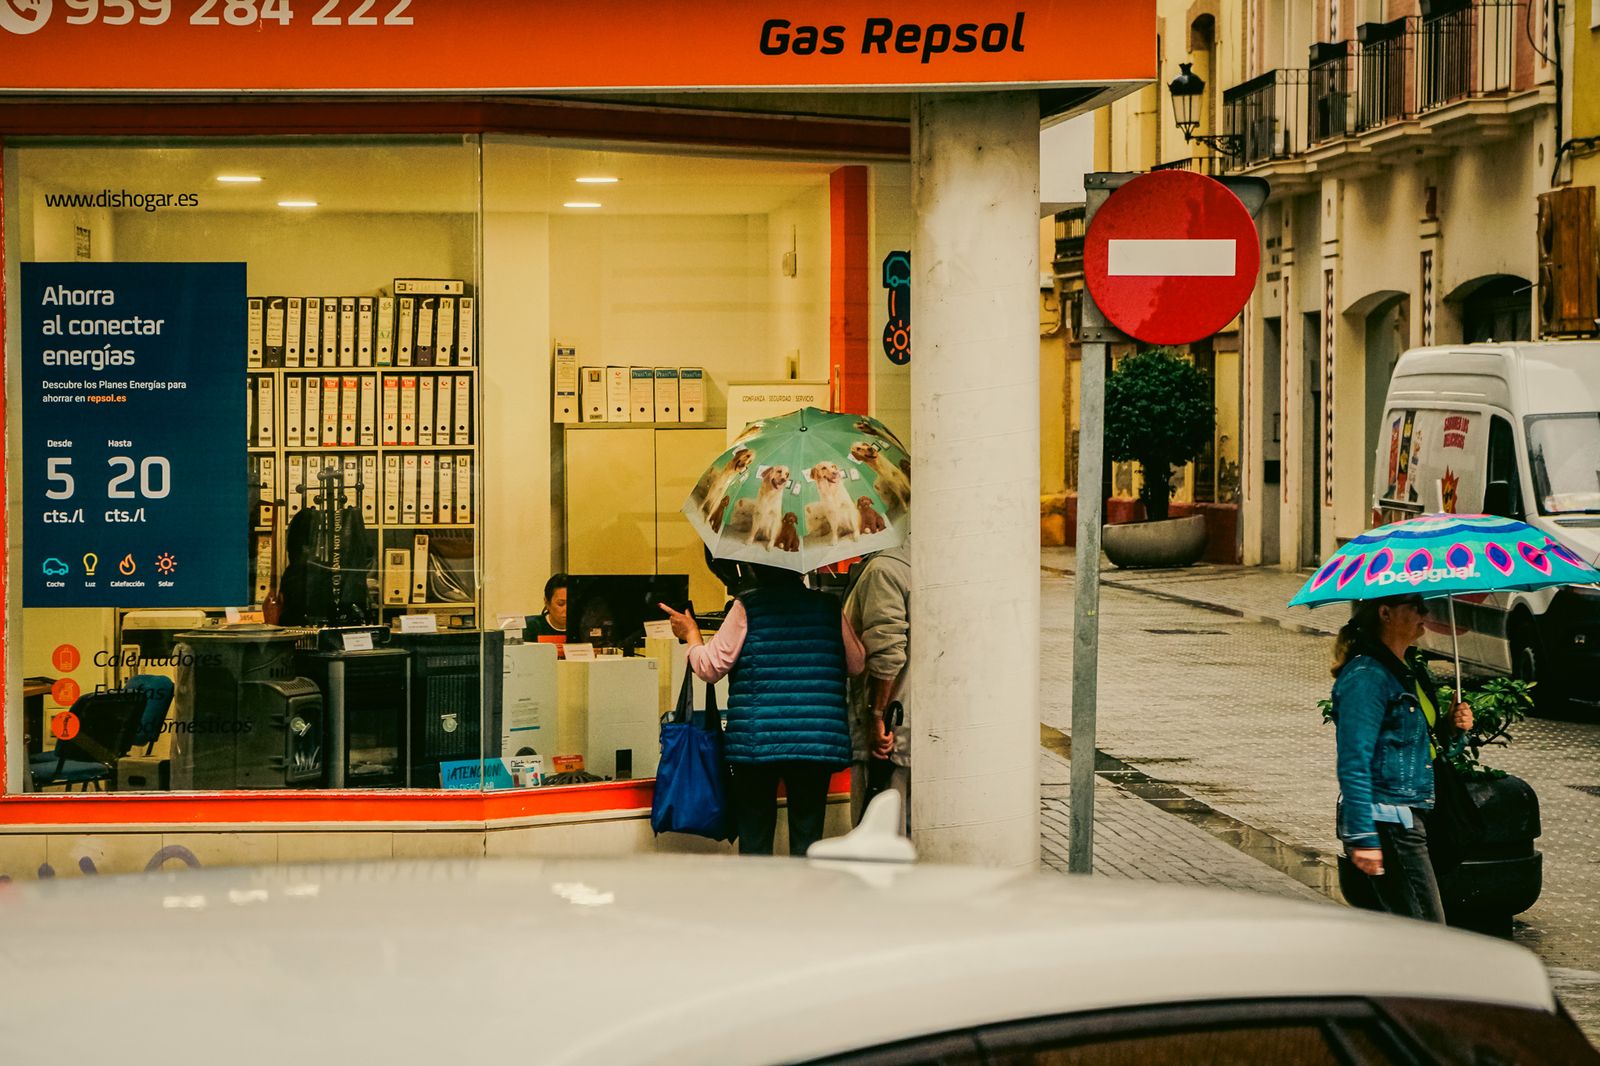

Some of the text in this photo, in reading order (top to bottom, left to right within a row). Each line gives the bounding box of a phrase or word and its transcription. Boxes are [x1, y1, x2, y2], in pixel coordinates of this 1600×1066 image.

[66, 0, 414, 26] 959 284 222
[758, 12, 1026, 64] Gas Repsol
[44, 189, 199, 213] www.dishogar.es
[41, 284, 115, 306] Ahorra
[42, 314, 165, 336] al conectar
[42, 343, 136, 371] energías
[42, 380, 187, 392] Descubre los Planes Energías para
[42, 394, 127, 404] ahorrar en repsol.es
[47, 439, 73, 448] Desde
[108, 439, 132, 448] Hasta
[45, 457, 75, 500] 5
[107, 456, 171, 499] 20
[43, 508, 85, 524] cts./l
[104, 507, 146, 523] cts./l
[158, 580, 174, 588] Solar
[93, 650, 223, 668] Calentadores
